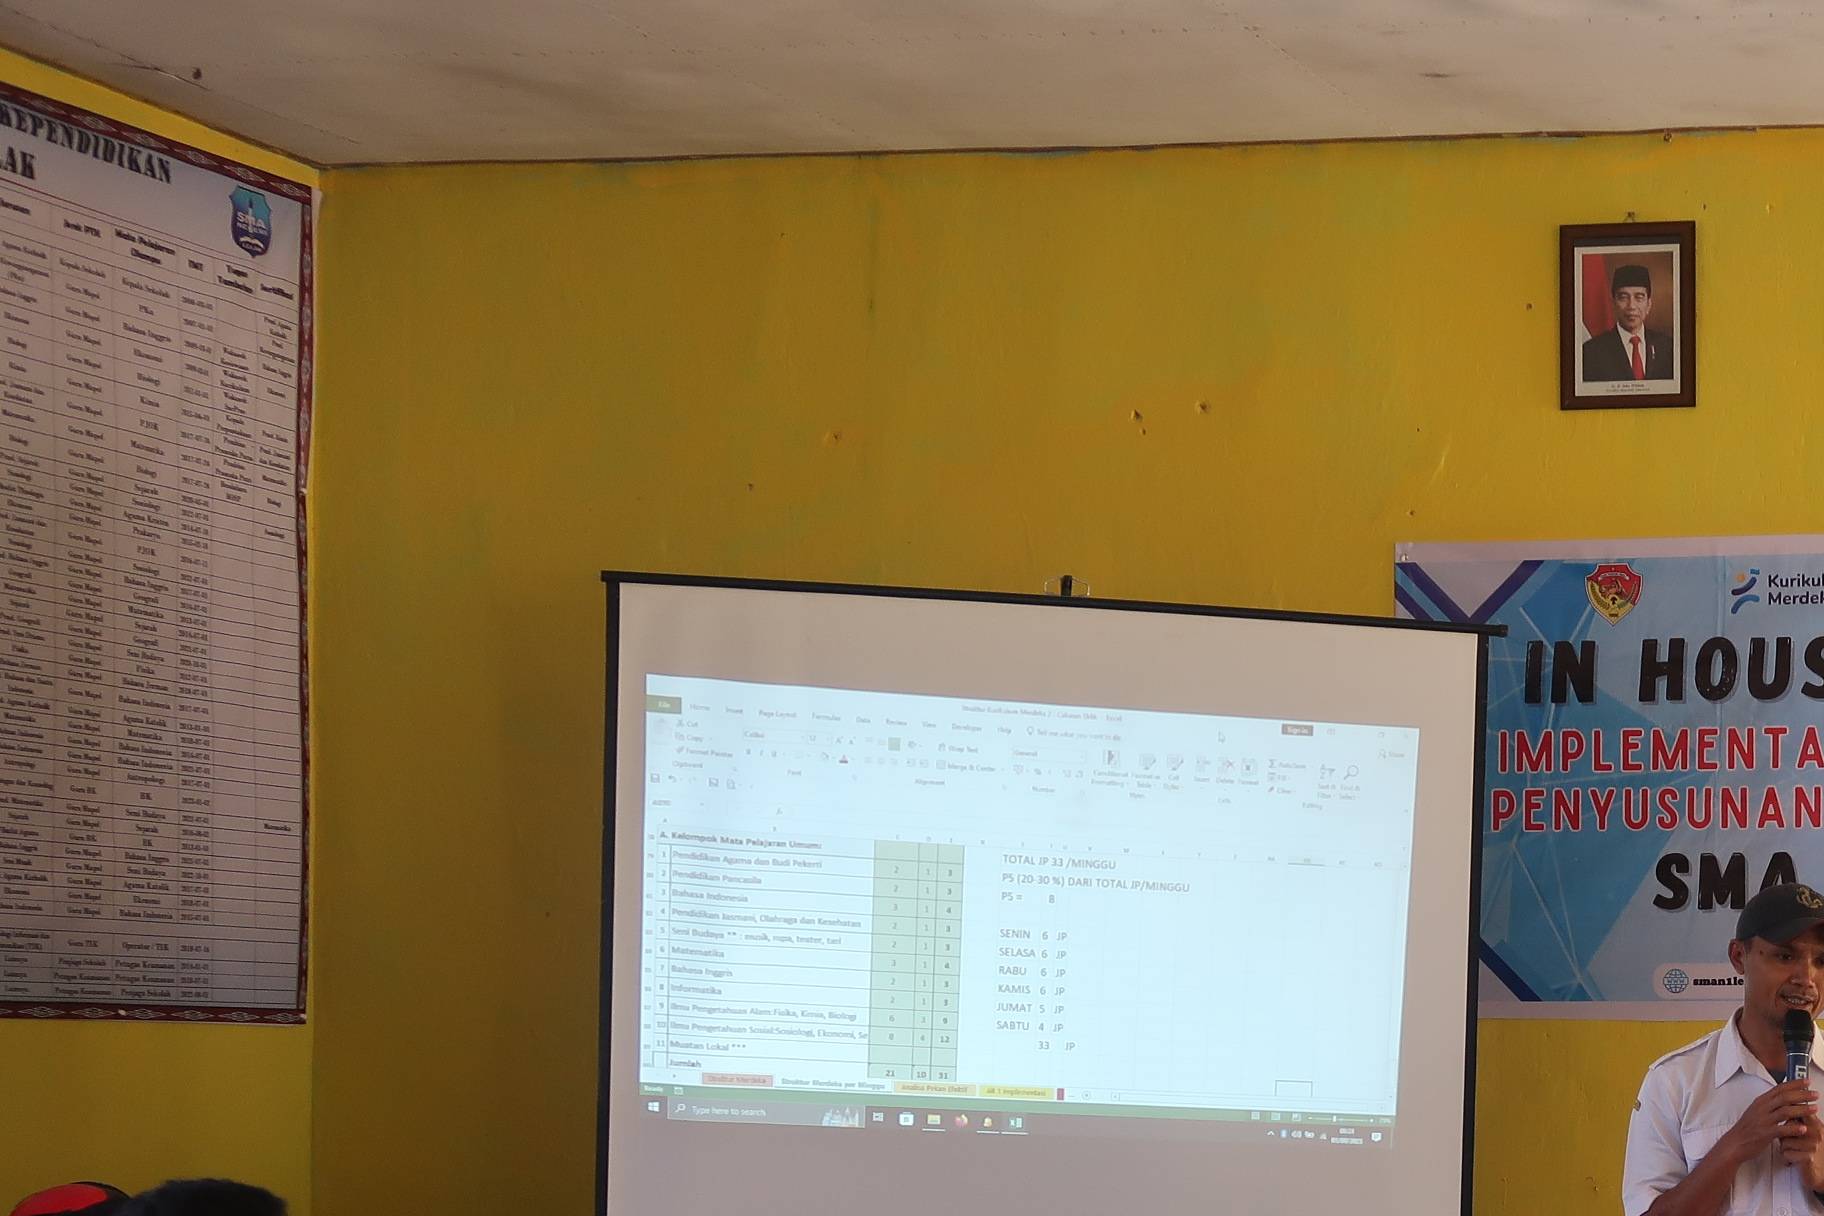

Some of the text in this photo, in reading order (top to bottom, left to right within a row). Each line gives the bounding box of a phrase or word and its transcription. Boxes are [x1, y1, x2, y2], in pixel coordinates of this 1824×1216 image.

[1523, 639, 1597, 703] IN
[1491, 785, 1823, 831] PENYUSUNAN
[671, 832, 717, 844] Kelompok
[720, 836, 744, 846] Mata
[672, 850, 720, 862] Pendidikan
[1002, 854, 1117, 871] TOTAL JP 33 /MINGGU
[672, 870, 720, 881] Pendidikan
[1067, 877, 1093, 888] DARI
[1096, 878, 1129, 890] TOTAL
[1130, 880, 1191, 893] JP/MINGGU
[1000, 928, 1068, 941] SENIN 6 JP
[999, 947, 1067, 960] SELASA 6 JP
[998, 965, 1066, 978] RABU 6 JP
[1693, 976, 1744, 986] sman1le
[997, 984, 1066, 996] KAMIS 6 JP
[996, 1002, 1065, 1015] JUMAT 5 JP
[996, 1020, 1064, 1033] SABTU 4 JP
[1037, 1040, 1077, 1051] 33 JP
[691, 1105, 767, 1118] Type here to search
